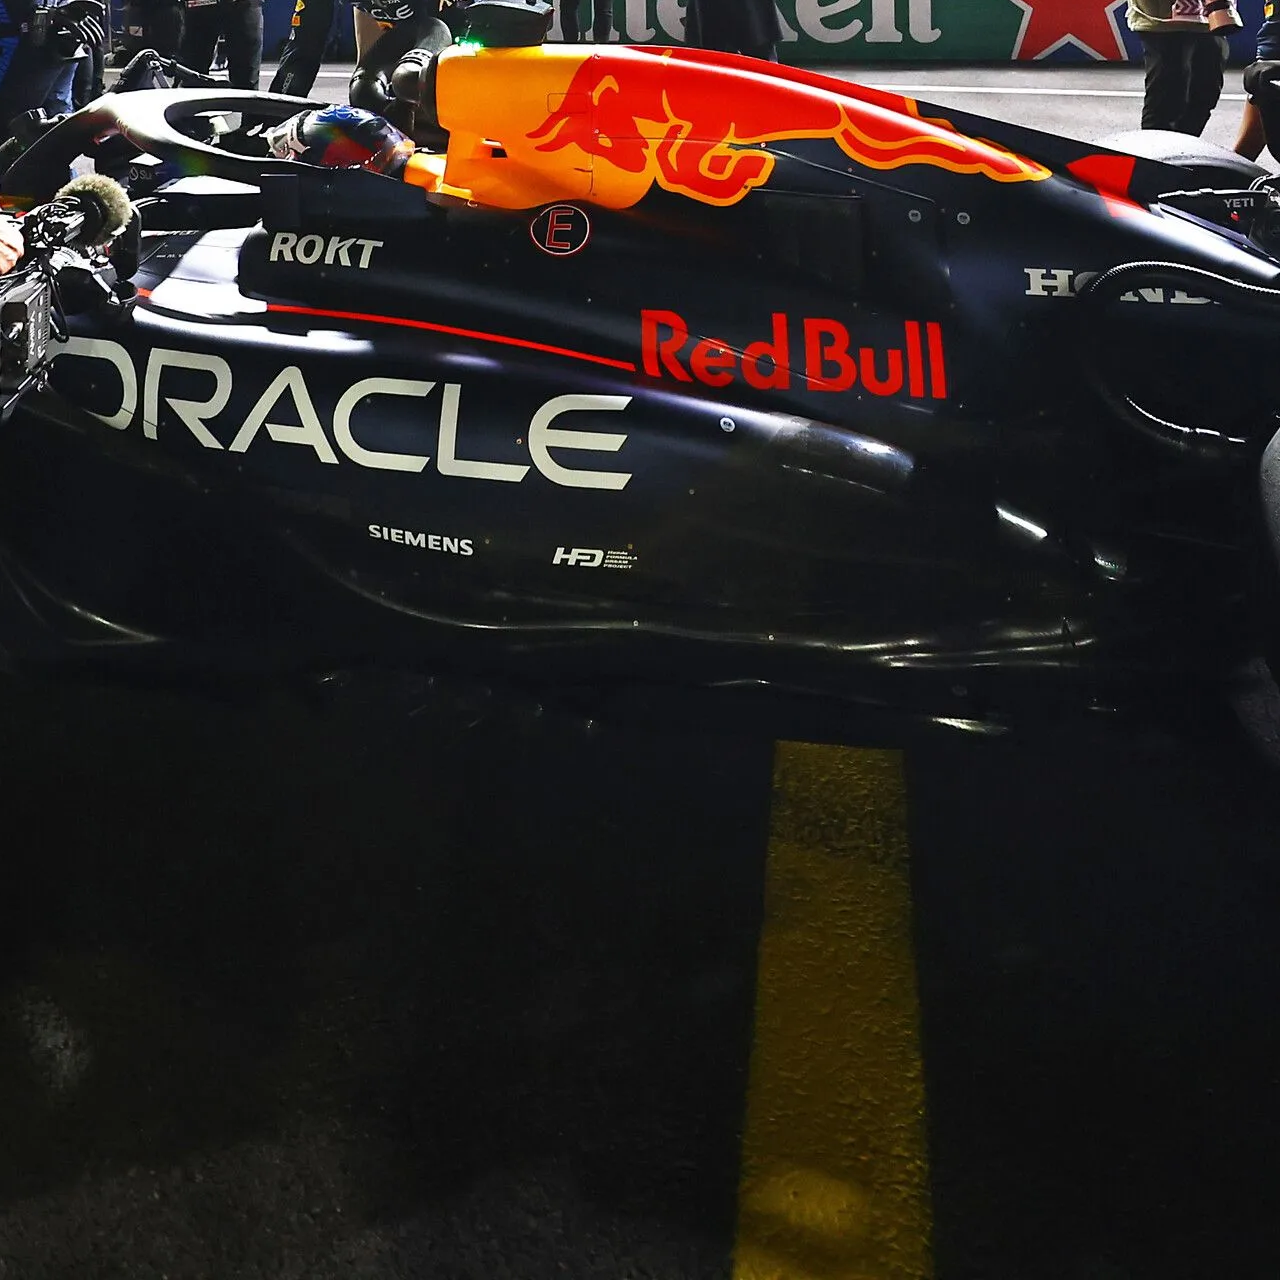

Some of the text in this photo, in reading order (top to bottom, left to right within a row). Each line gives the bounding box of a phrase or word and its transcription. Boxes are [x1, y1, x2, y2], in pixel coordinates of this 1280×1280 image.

[1223, 198, 1255, 210] YETI
[547, 210, 574, 249] E
[270, 231, 384, 269] ROKT
[641, 309, 947, 399] Red Bull
[45, 337, 633, 490] ORACLE
[369, 524, 474, 556] SIEMENS
